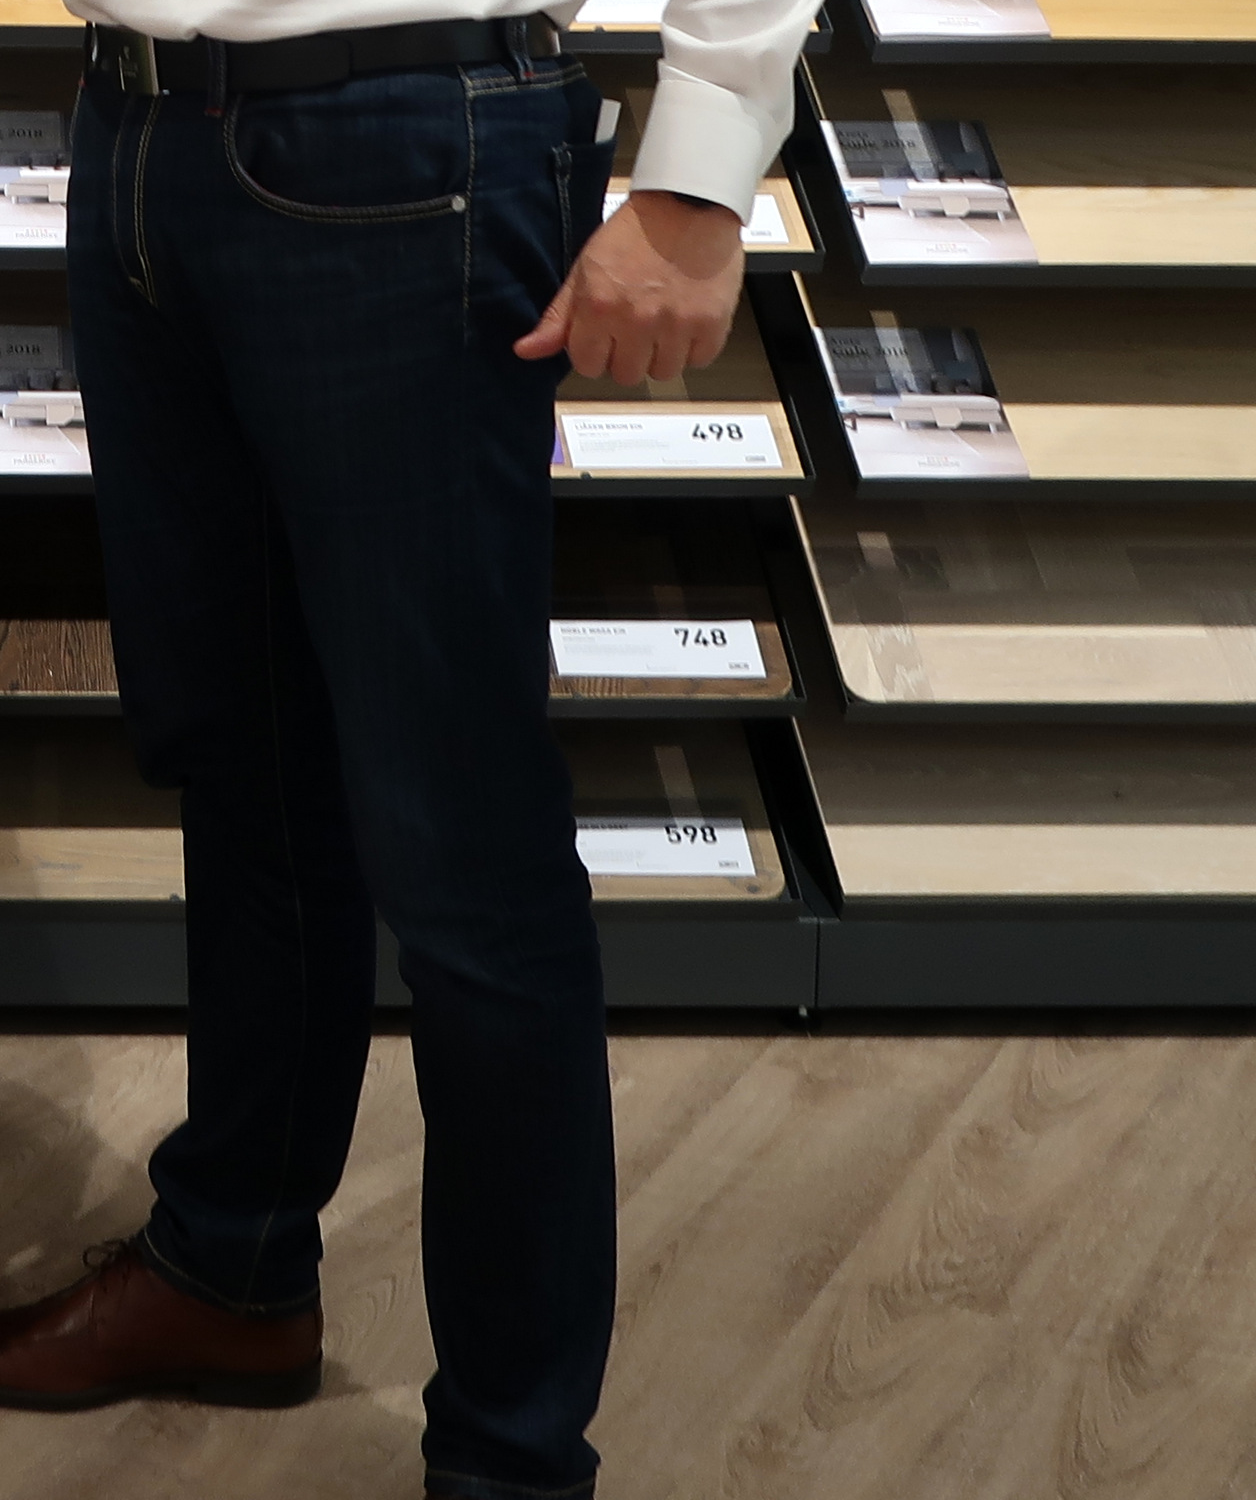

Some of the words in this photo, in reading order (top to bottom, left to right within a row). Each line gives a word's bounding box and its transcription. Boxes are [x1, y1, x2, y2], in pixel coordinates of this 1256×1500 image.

[692, 422, 744, 442] 498
[674, 627, 728, 647] 748
[665, 825, 718, 845] 598
